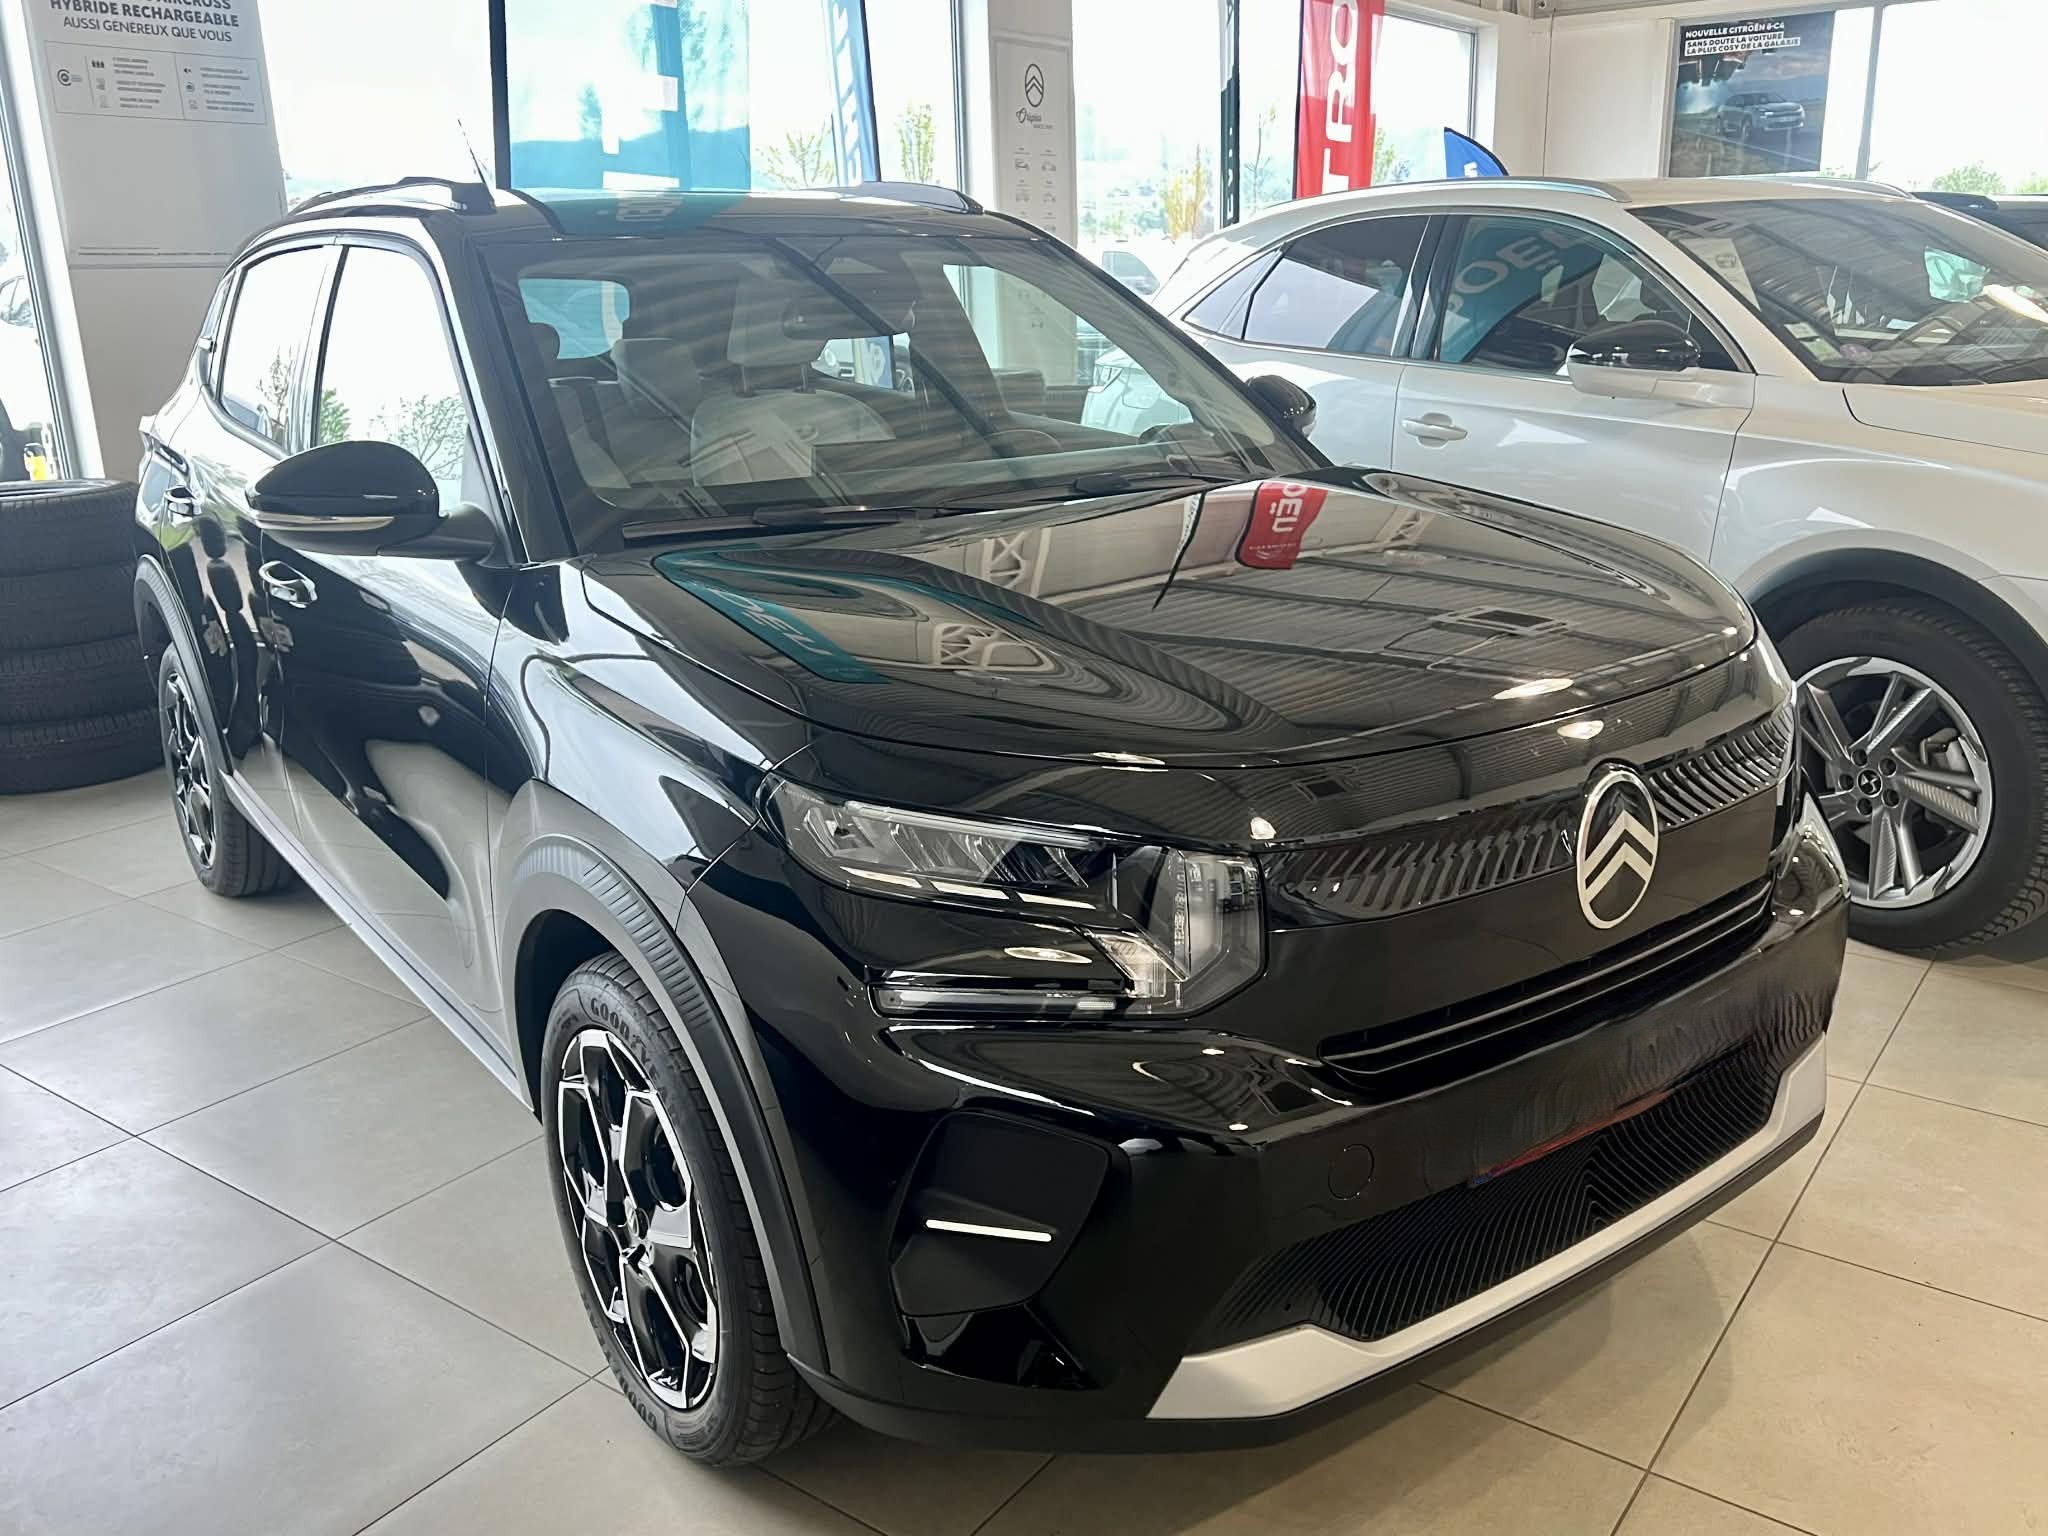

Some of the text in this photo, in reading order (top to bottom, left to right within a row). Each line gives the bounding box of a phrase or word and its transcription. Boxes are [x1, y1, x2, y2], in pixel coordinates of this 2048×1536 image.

[50, 0, 239, 27] HYBRIDE RECHARGEABLE
[63, 16, 100, 30] AUSSI
[171, 26, 197, 39] QUE
[198, 28, 232, 42] VOUS
[1685, 27, 1728, 39] NOUVELLE
[1688, 40, 1708, 48] SANS
[1747, 33, 1783, 41] VOITURE
[1718, 44, 1739, 52] COSY
